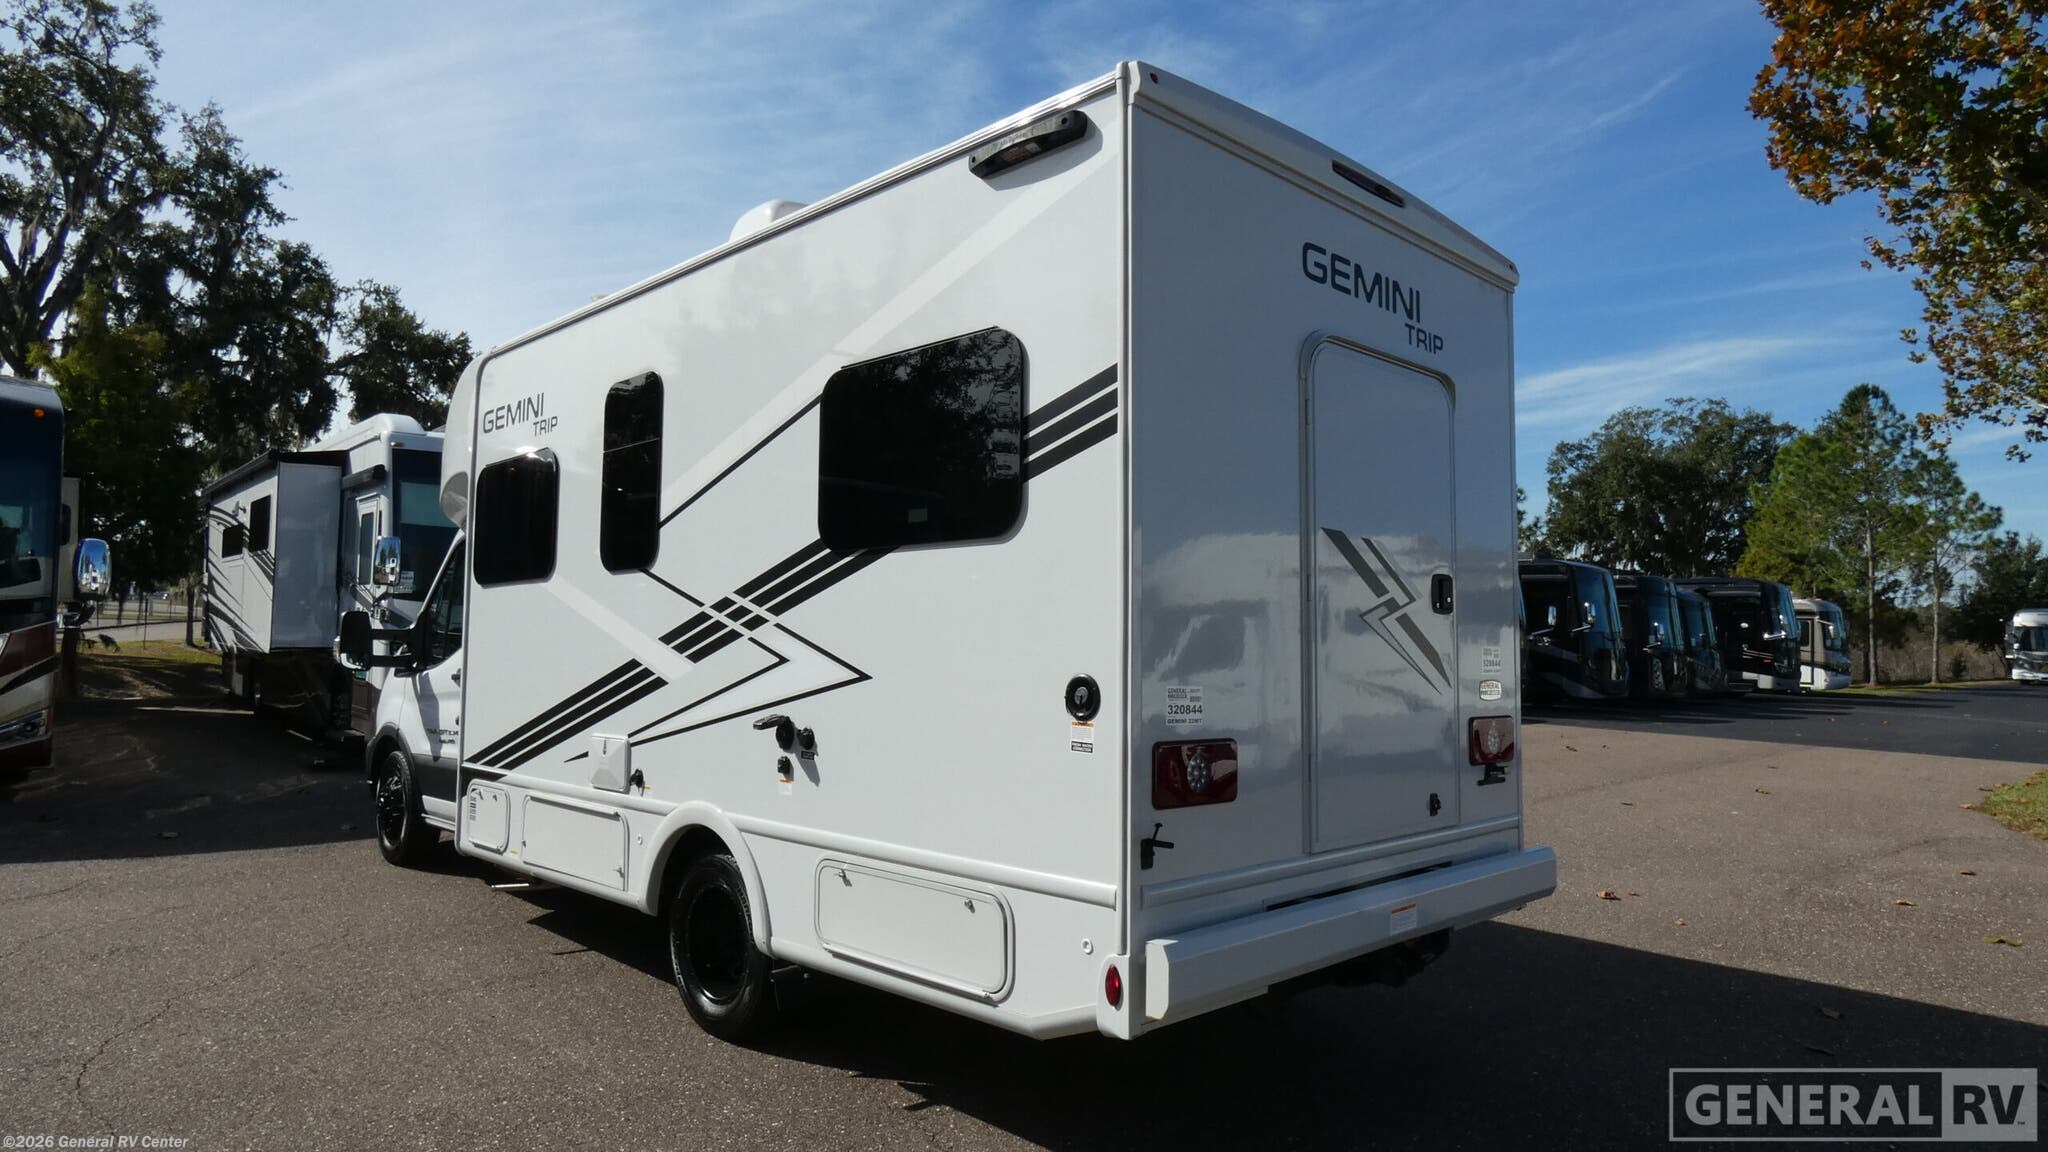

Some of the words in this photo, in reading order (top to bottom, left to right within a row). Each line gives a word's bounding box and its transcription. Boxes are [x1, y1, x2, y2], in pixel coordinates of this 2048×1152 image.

[1302, 242, 1421, 323] GEMINI
[1404, 322, 1444, 355] TRIP
[483, 392, 544, 434] GEMINI
[533, 416, 558, 437] TRIP
[1167, 704, 1203, 715] 320844
